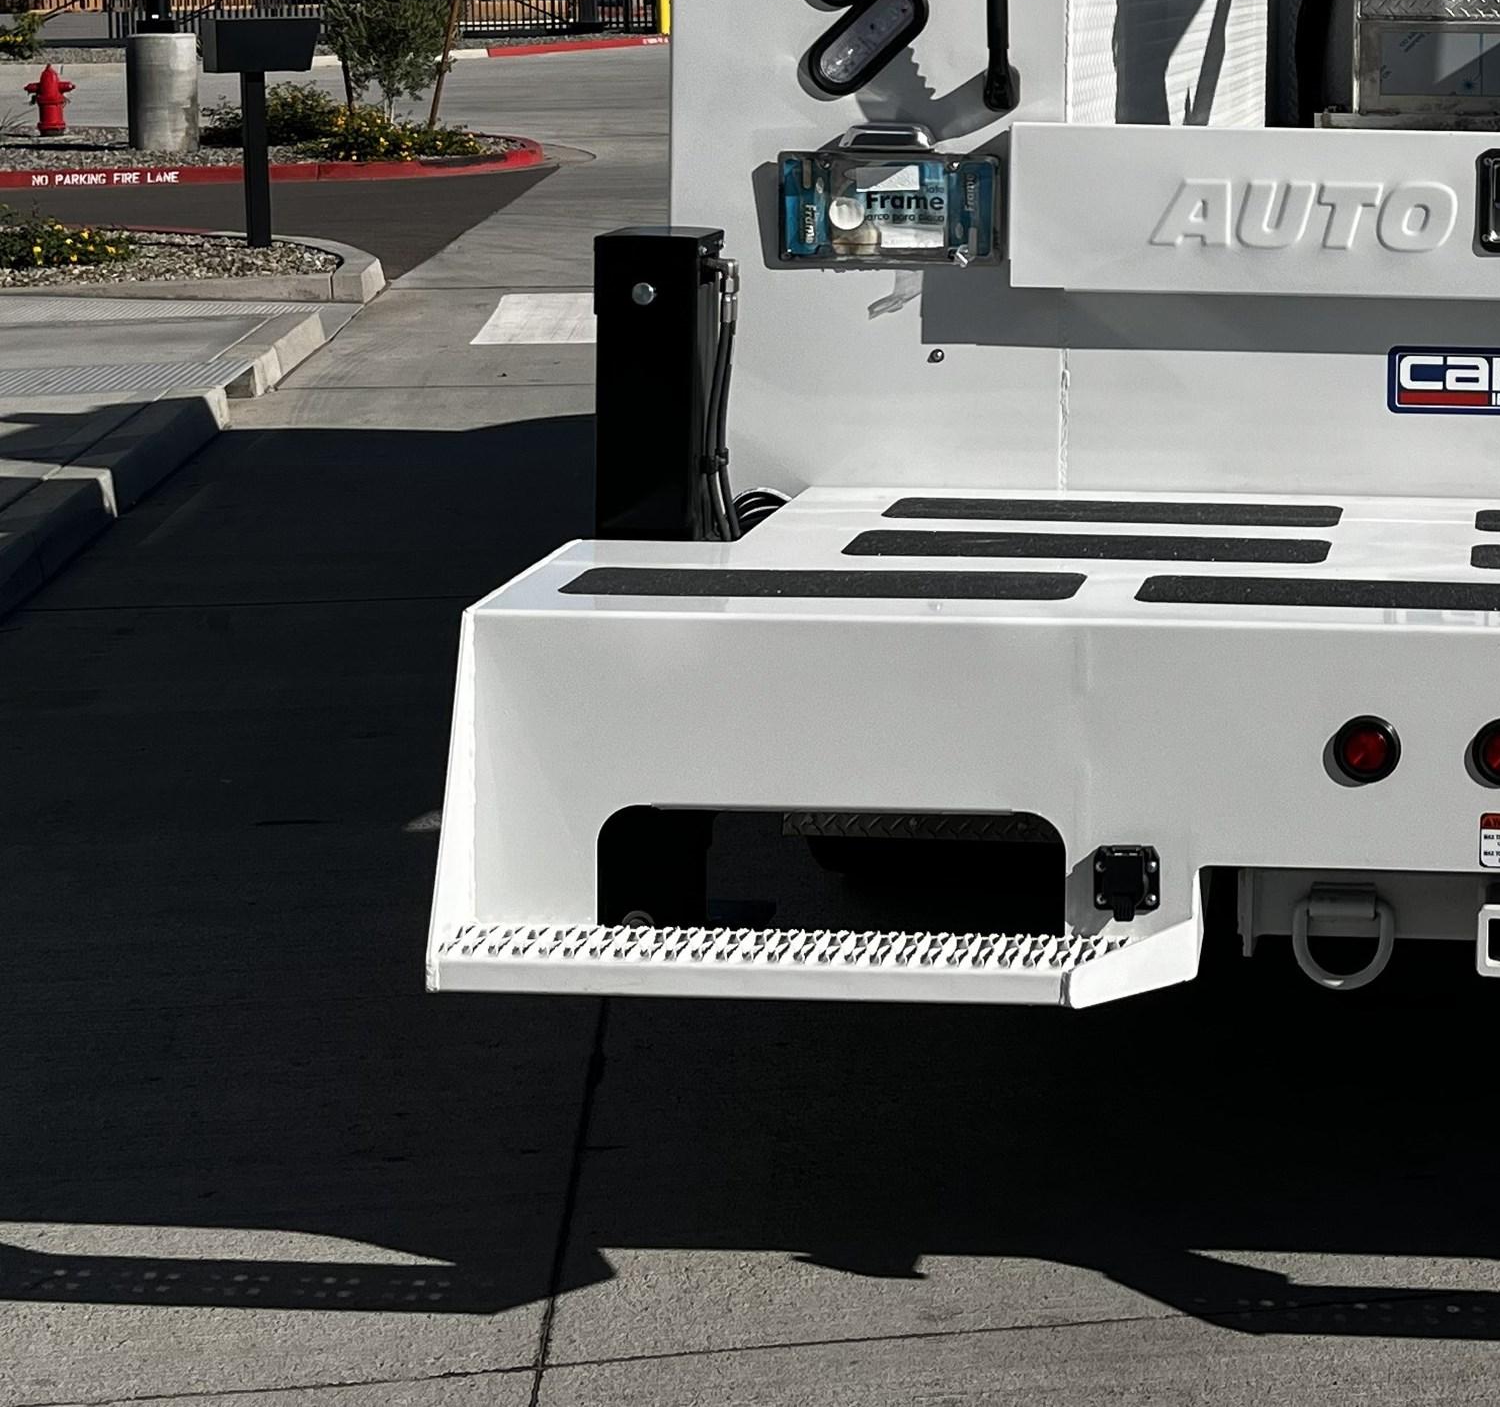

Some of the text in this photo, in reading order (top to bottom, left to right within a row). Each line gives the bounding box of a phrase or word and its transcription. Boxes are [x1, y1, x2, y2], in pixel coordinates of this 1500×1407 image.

[31, 171, 179, 186] NO PARKING FIRE LANE
[866, 193, 945, 211] Frame
[1147, 179, 1458, 253] AUTO
